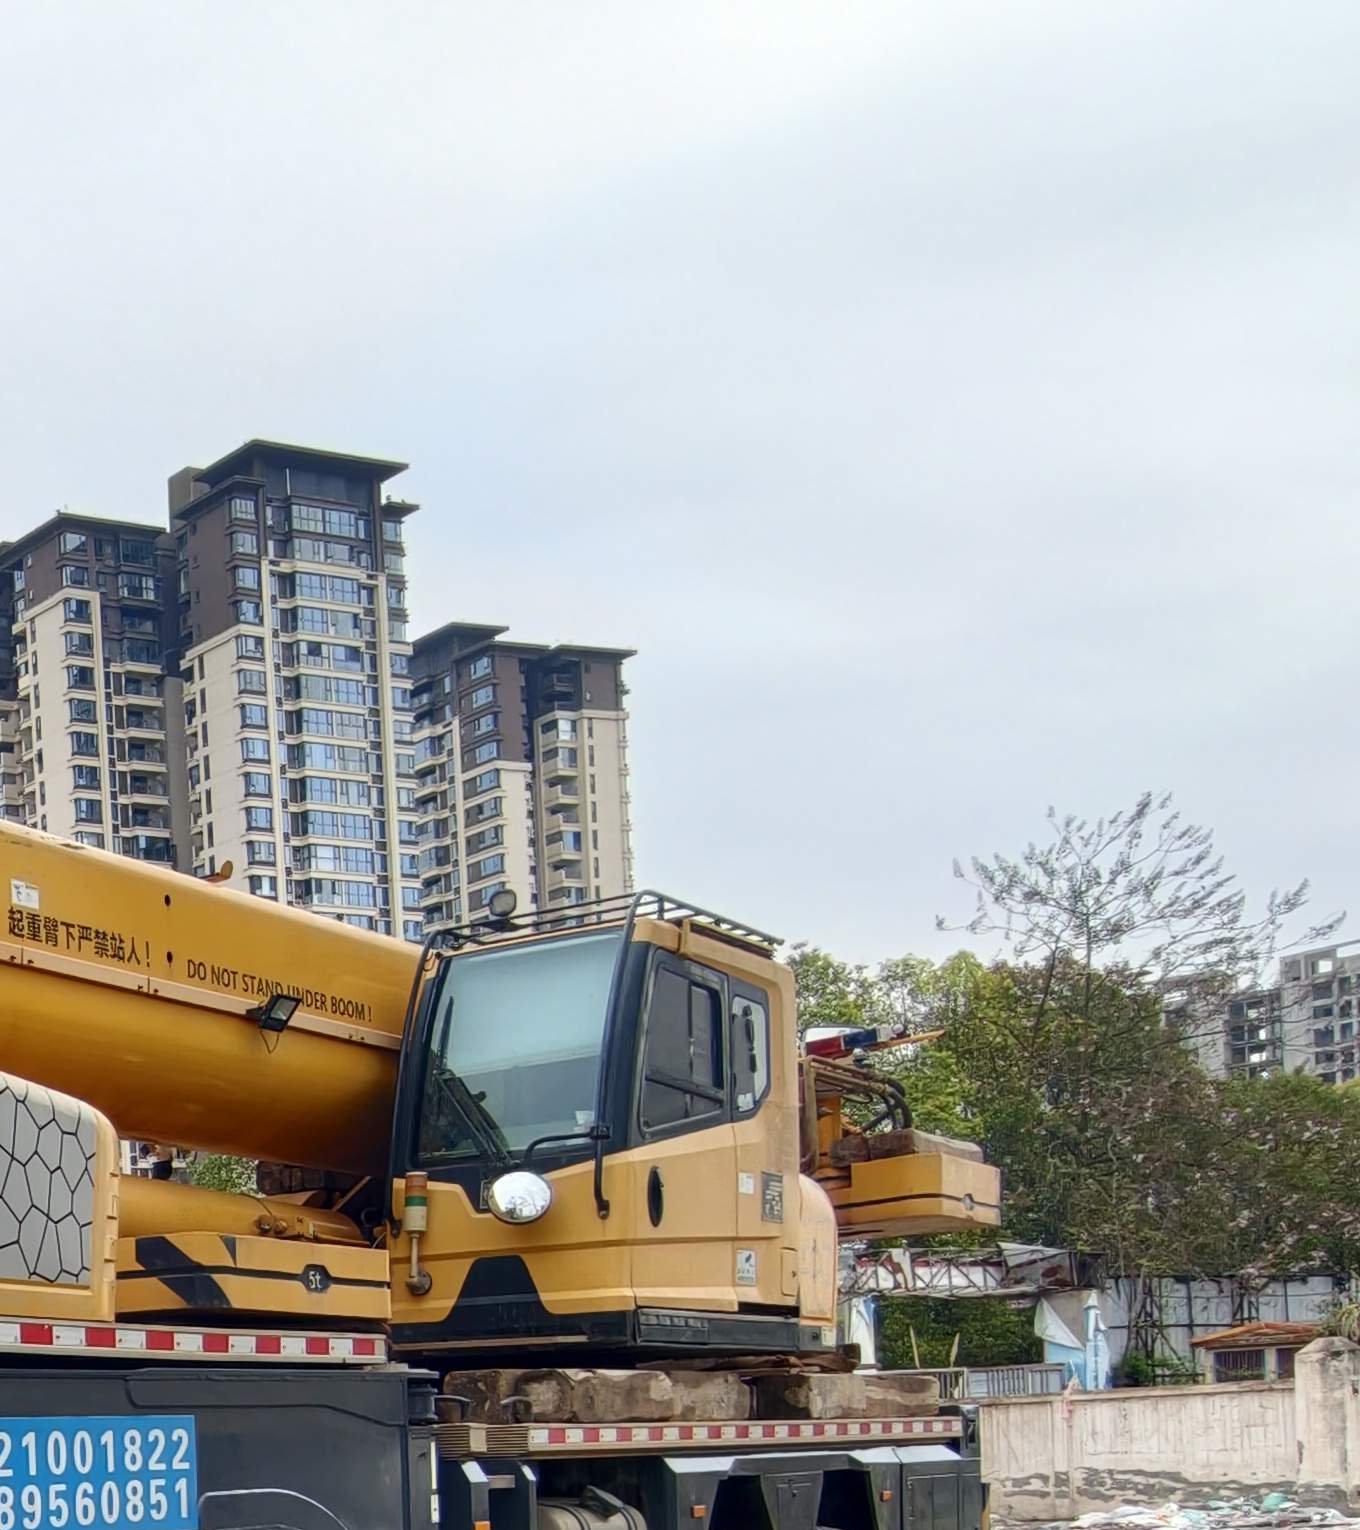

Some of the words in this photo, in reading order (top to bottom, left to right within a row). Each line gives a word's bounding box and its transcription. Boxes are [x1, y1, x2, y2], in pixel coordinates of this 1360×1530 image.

[187, 960, 207, 981] DO
[211, 965, 238, 990] NOT
[309, 1271, 322, 1289] 5t
